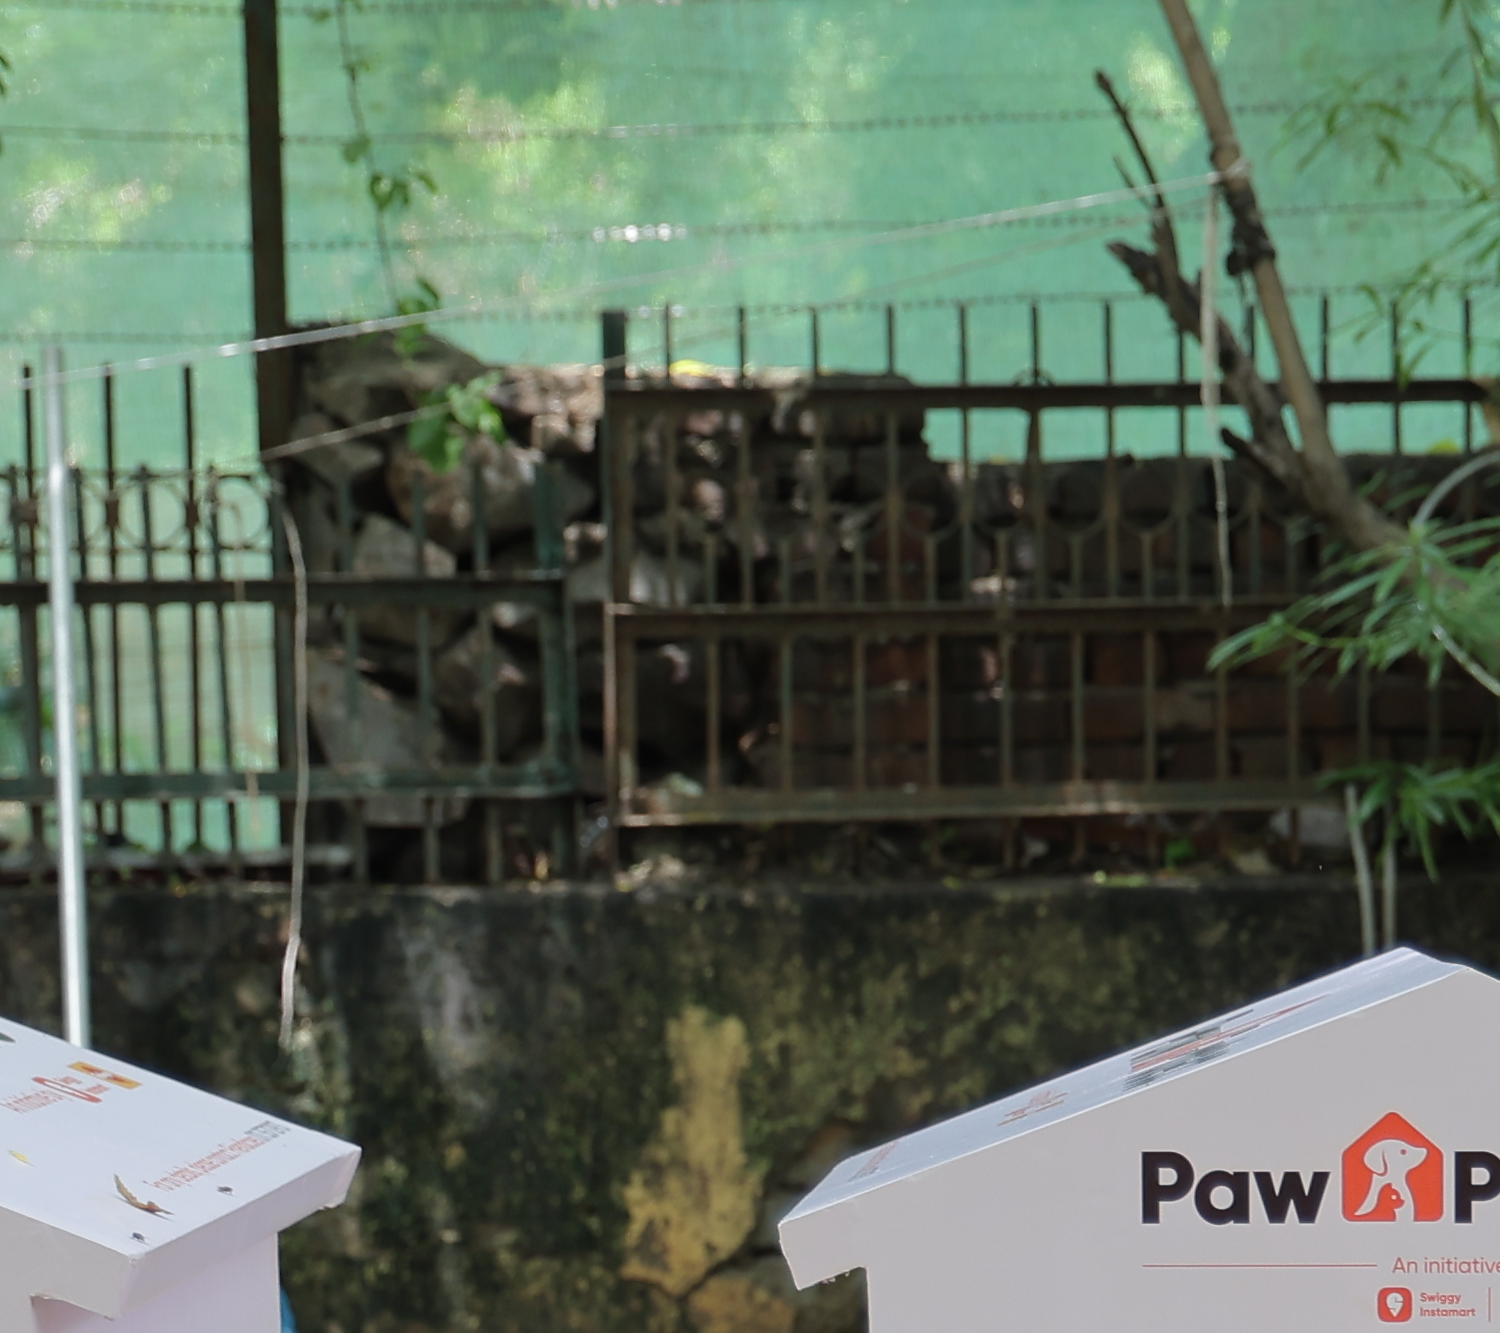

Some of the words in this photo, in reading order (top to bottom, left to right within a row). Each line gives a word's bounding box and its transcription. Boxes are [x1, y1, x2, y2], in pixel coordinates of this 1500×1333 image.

[1141, 1150, 1330, 1225] Paw
[1392, 1257, 1418, 1274] An
[1420, 1292, 1461, 1305] Swiggy
[1419, 1307, 1476, 1317] Instamart
